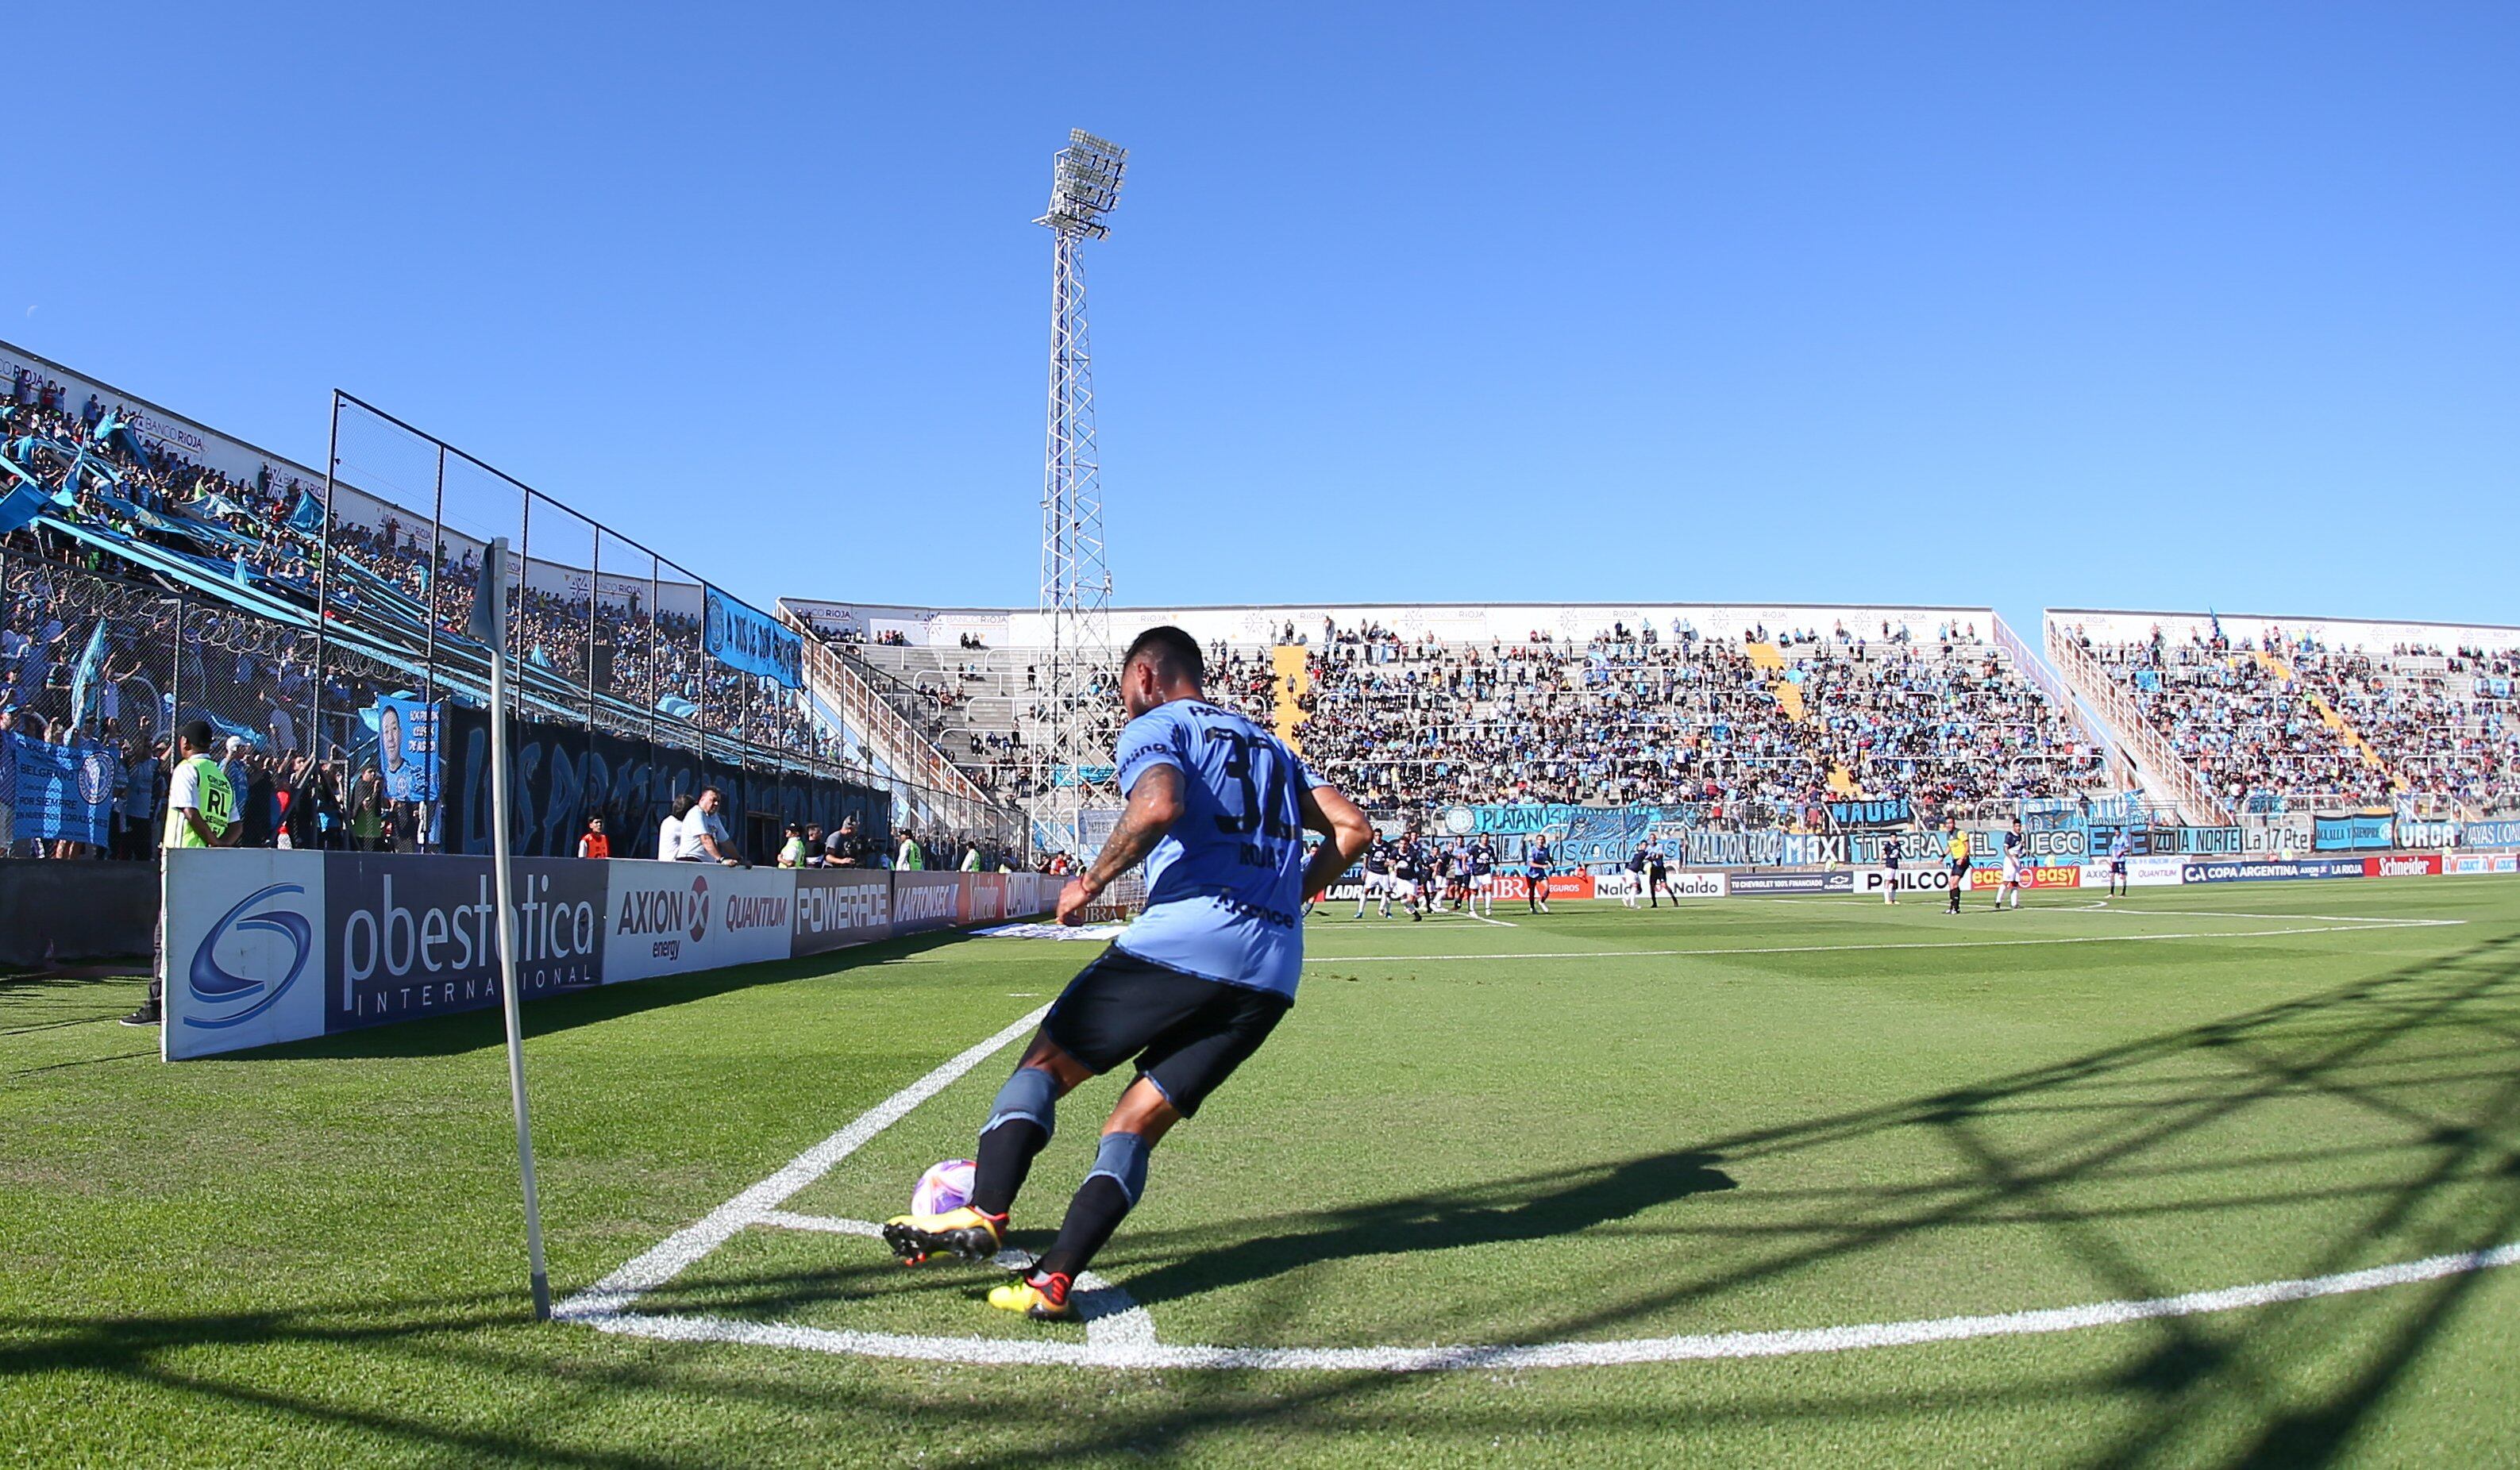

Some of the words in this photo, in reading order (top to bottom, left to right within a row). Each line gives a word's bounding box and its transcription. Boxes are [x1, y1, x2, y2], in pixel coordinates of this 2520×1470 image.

[145, 416, 178, 441] BANCO
[590, 580, 618, 592] ANCO
[946, 615, 980, 624] BANCO
[20, 764, 75, 782] BELGRANO
[19, 796, 35, 806] POR
[35, 797, 77, 810] SIEMPRE
[207, 789, 228, 817] RL
[1482, 806, 1559, 830] PLATANOS
[1688, 833, 1778, 864] MALDONADO
[2196, 829, 2237, 851] NORTE
[2245, 829, 2261, 850] La
[2265, 828, 2280, 850] 17
[2284, 828, 2309, 850] Pte
[1239, 841, 1285, 872] ROJAS
[1786, 835, 1846, 864] MAXI
[2036, 867, 2077, 885] easy
[2086, 869, 2113, 878] AXIO
[2138, 869, 2177, 878] QUANTIUM
[2208, 867, 2238, 879] COPA
[2239, 865, 2298, 877] ARGENTINA
[2331, 865, 2341, 874] LA
[2342, 864, 2363, 874] RIOJA
[2379, 856, 2430, 876] Schneider
[1789, 879, 1823, 887] FINANCIADO
[1972, 870, 2003, 883] eas
[1674, 881, 1718, 894] Naldo
[617, 890, 684, 935] AXION
[726, 895, 788, 932] QUANTIUM
[796, 883, 887, 935] POWERADE
[653, 940, 680, 960] energy
[358, 964, 591, 1017] INTERNAIONAL
